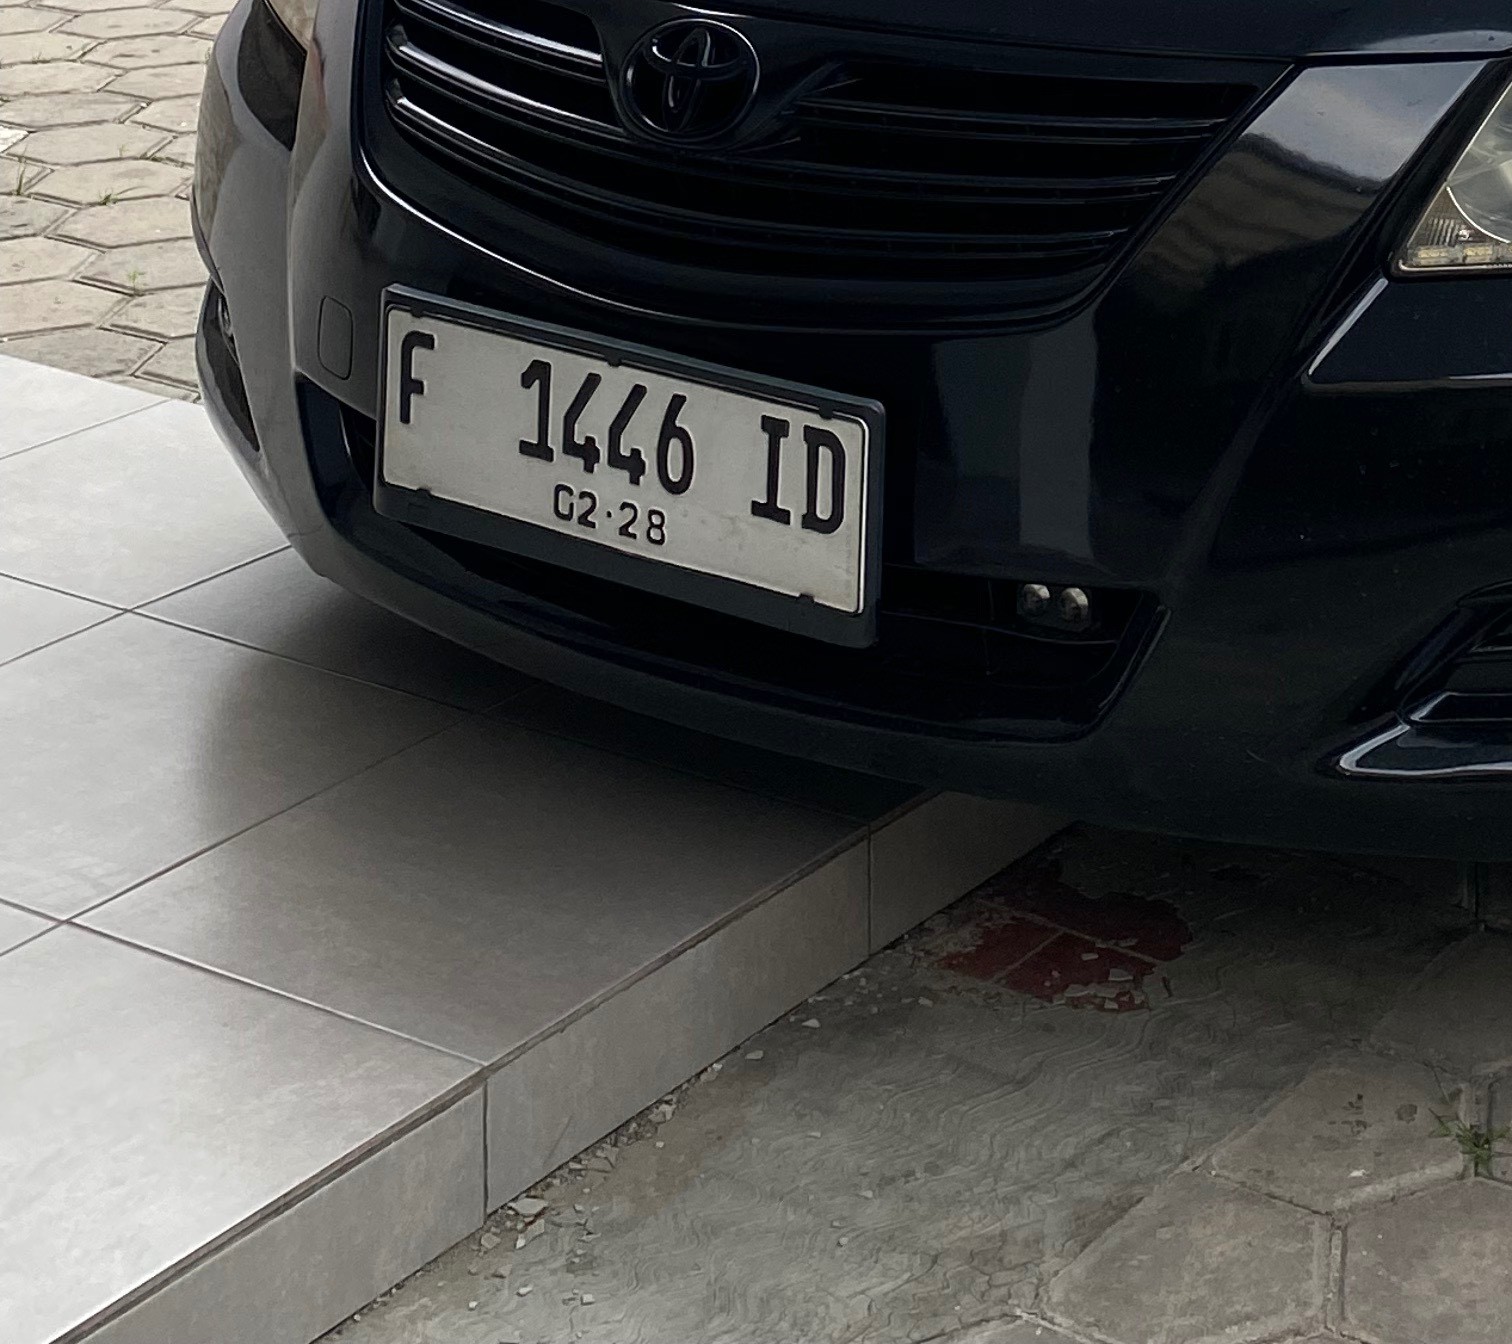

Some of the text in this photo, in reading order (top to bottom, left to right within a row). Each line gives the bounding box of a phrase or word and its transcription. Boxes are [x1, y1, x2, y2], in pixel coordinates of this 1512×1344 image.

[400, 330, 847, 535] F 1446 ID
